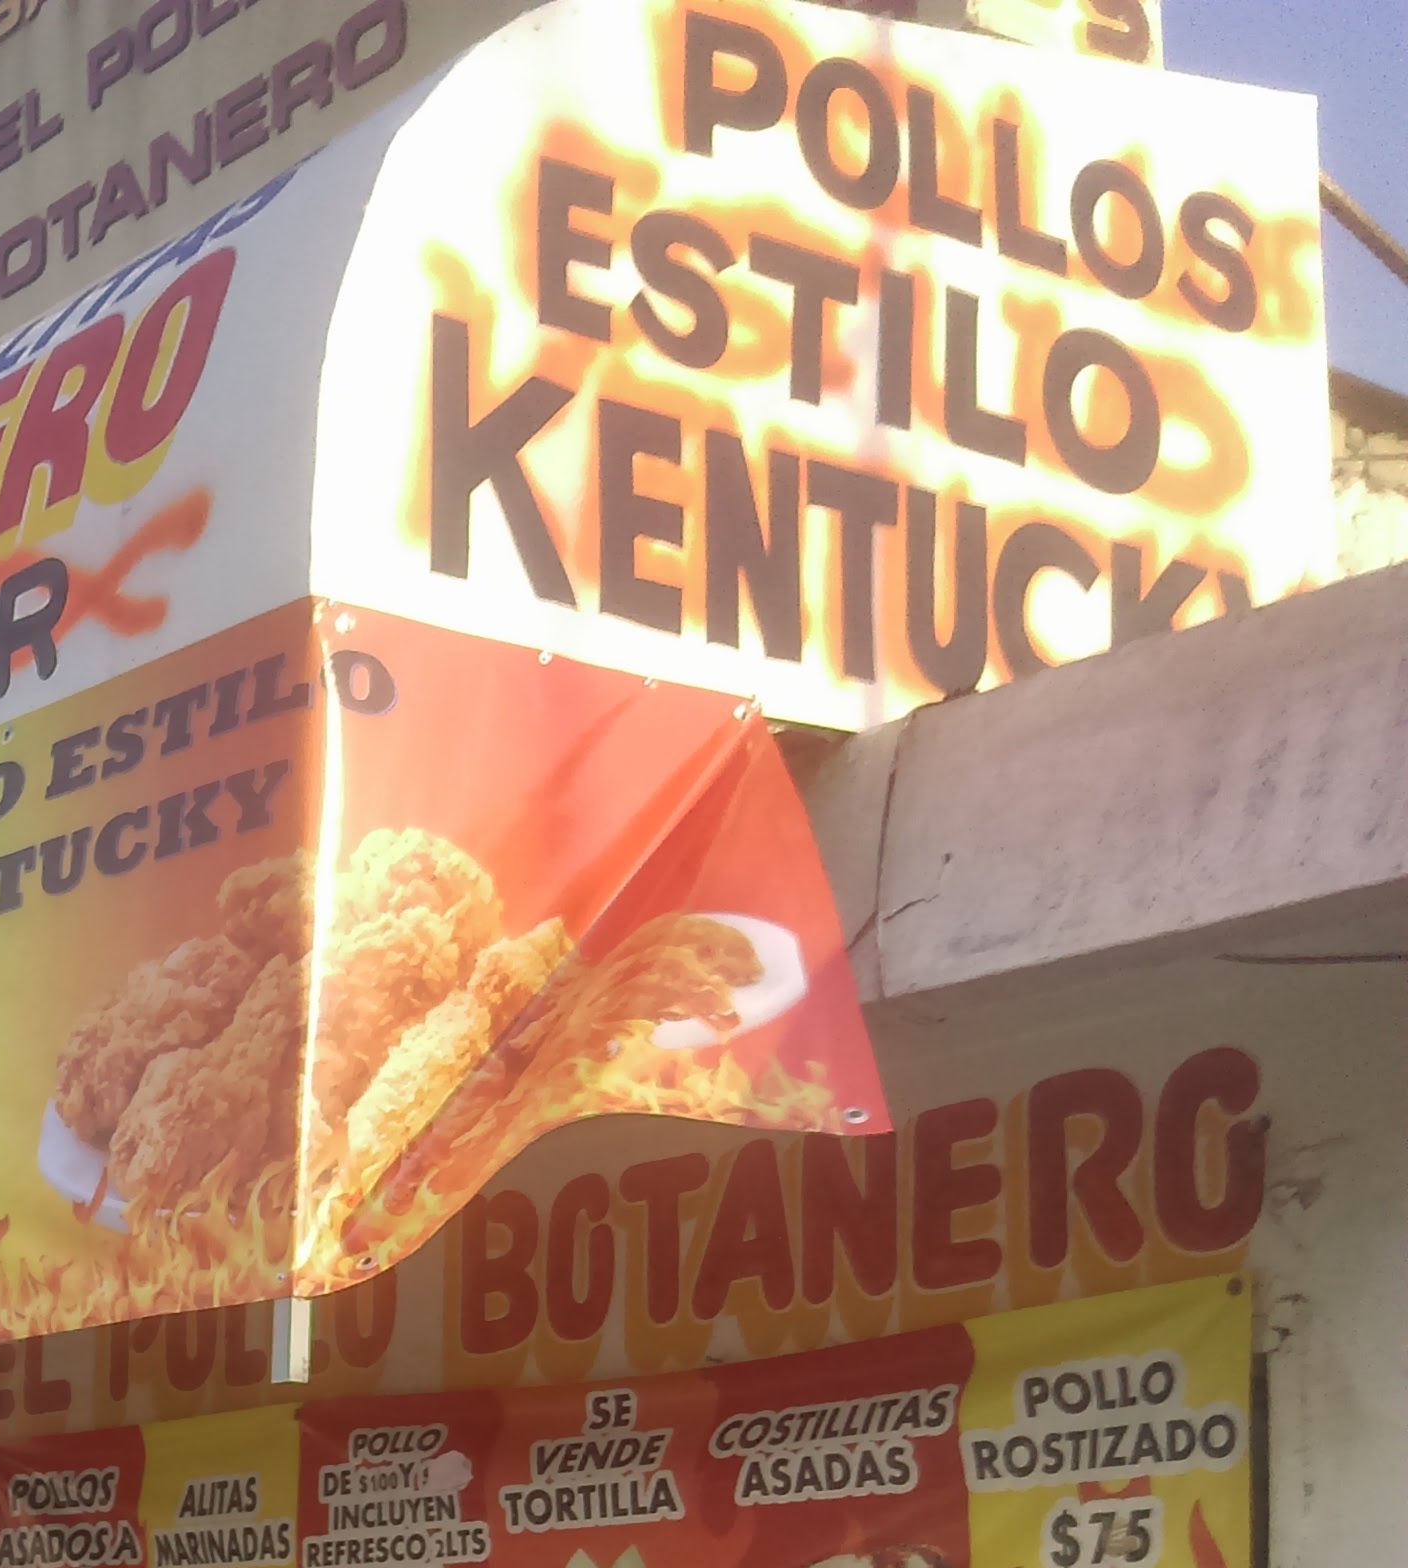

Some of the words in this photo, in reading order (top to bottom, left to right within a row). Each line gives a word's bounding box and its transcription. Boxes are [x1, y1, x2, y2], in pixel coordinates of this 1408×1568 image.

[87, 0, 260, 111] POL
[683, 10, 1259, 334] POLLOS
[537, 156, 1160, 494] ESTILO
[44, 648, 398, 800] ESTILO
[109, 1268, 398, 1402] POLO
[458, 1044, 1268, 1358] BOTANERO
[588, 1392, 632, 1430] SE
[1023, 1359, 1176, 1418] POLLO
[352, 1429, 442, 1458] POLLO
[715, 1388, 956, 1452] COSTILLITAS
[534, 1433, 666, 1476] VENDE
[741, 1445, 913, 1499] ASADAS
[972, 1413, 1237, 1481] ROSTIZADO
[11, 1470, 116, 1512] POLLOS
[179, 1476, 258, 1519] ALITAS
[323, 1470, 351, 1497] DE
[505, 1476, 679, 1527] TORTILLA
[333, 1494, 456, 1531] INCLUYEN
[111, 1525, 138, 1560] A
[154, 1522, 291, 1568] MARINADAS
